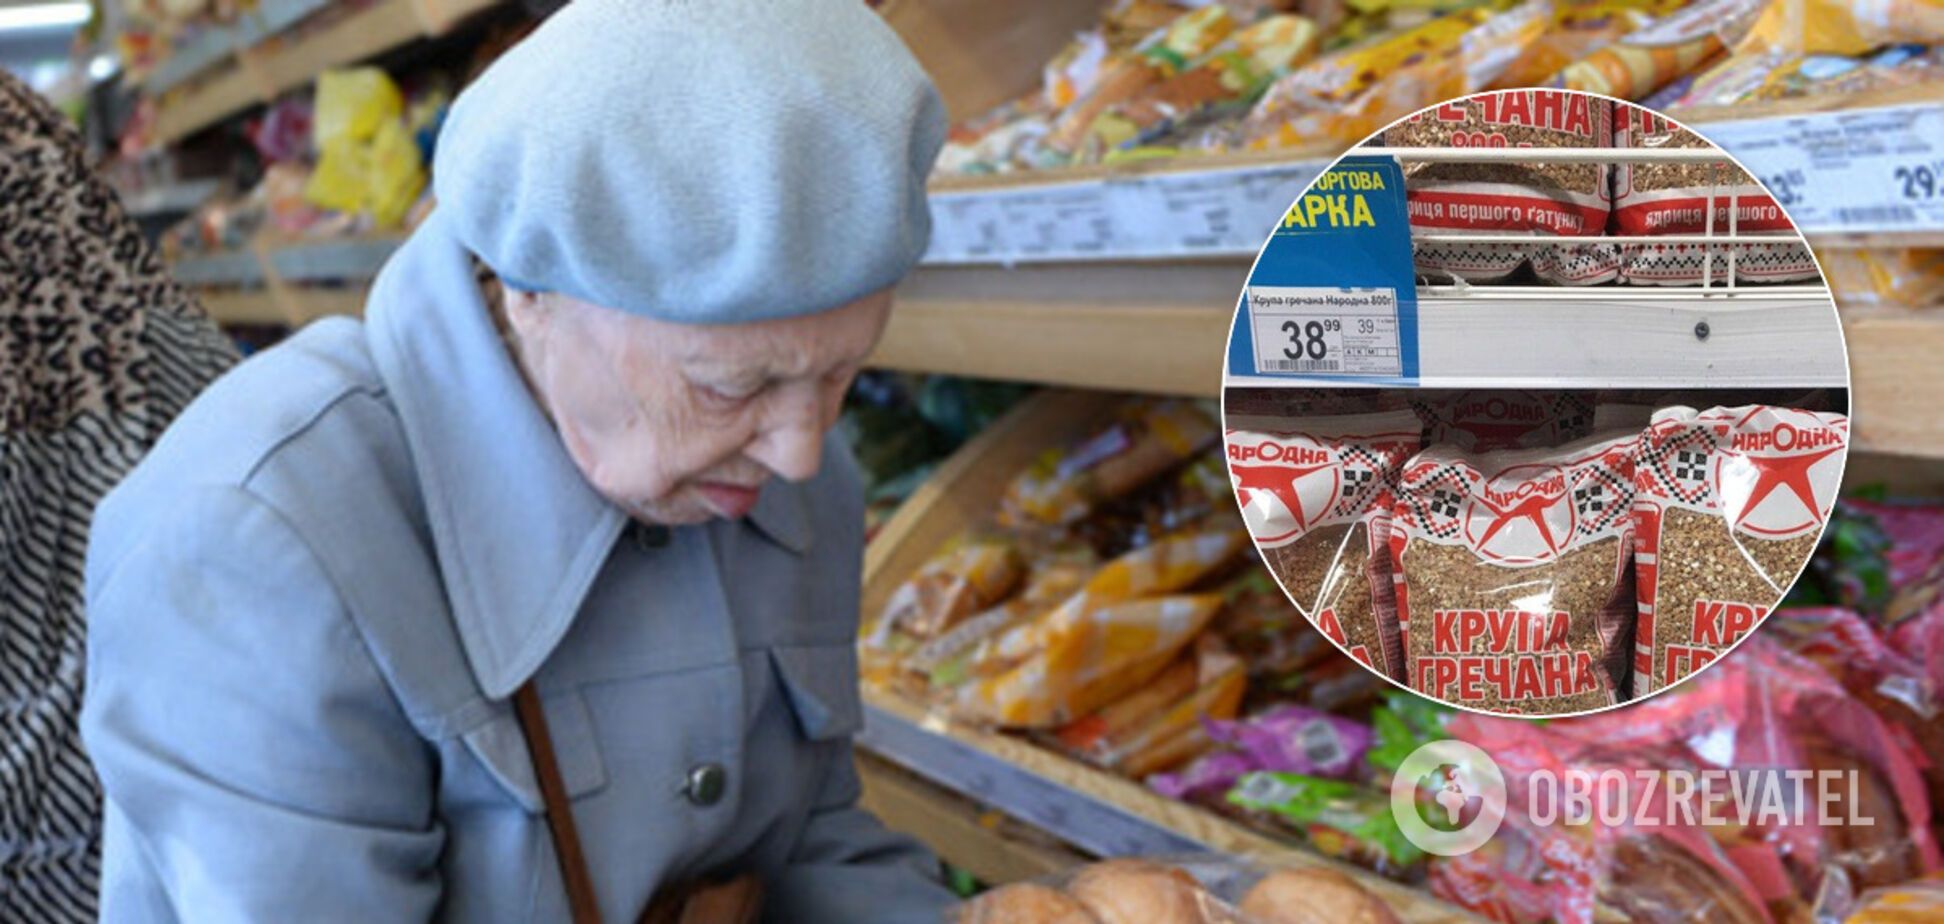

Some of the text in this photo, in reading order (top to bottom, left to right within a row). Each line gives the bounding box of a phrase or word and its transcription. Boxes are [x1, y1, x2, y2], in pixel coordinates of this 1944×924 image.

[1894, 165, 1935, 199] 29
[1280, 194, 1376, 228] АРКА
[1449, 202, 1521, 224] першого
[1645, 207, 1702, 228] ядриця
[1254, 295, 1283, 307] Крупа
[1286, 296, 1323, 307] гречана
[1326, 295, 1369, 307] Народна
[1358, 319, 1374, 334] 39
[1281, 320, 1327, 360] 38
[1323, 319, 1341, 332] 99
[1453, 399, 1544, 422] НАРОДНА
[1227, 441, 1328, 465] АРОДНА
[1434, 609, 1571, 654] КРУПА
[1417, 651, 1598, 701] ГРЕЧАНА
